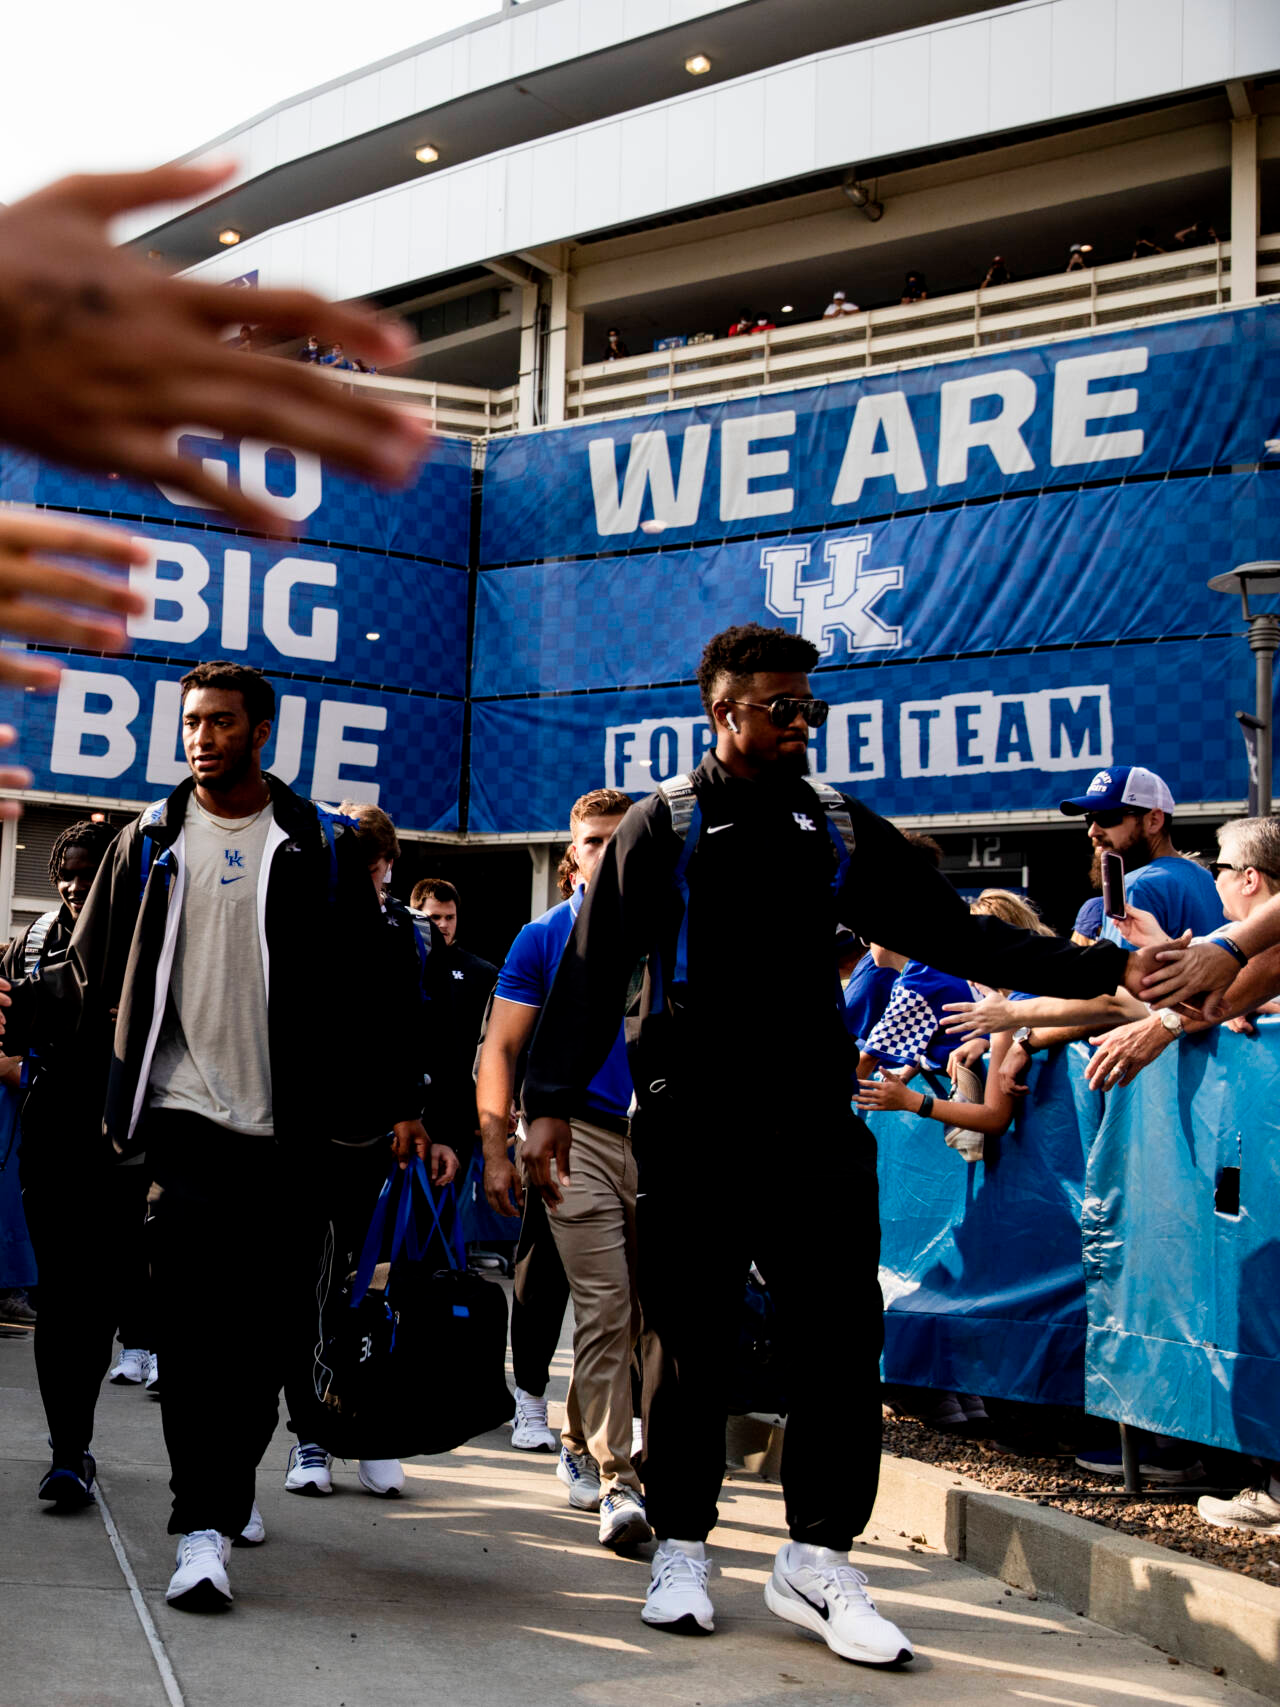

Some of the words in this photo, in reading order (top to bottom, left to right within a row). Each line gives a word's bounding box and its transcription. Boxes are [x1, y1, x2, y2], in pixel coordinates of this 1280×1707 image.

[154, 428, 323, 522] GO
[588, 409, 797, 536] WE
[831, 346, 1149, 505] ARE
[126, 536, 338, 662] BIG
[760, 533, 904, 657] UK
[908, 695, 1102, 769] TEAM
[224, 849, 245, 868] UK
[792, 811, 817, 831] UK
[968, 837, 1002, 867] 12
